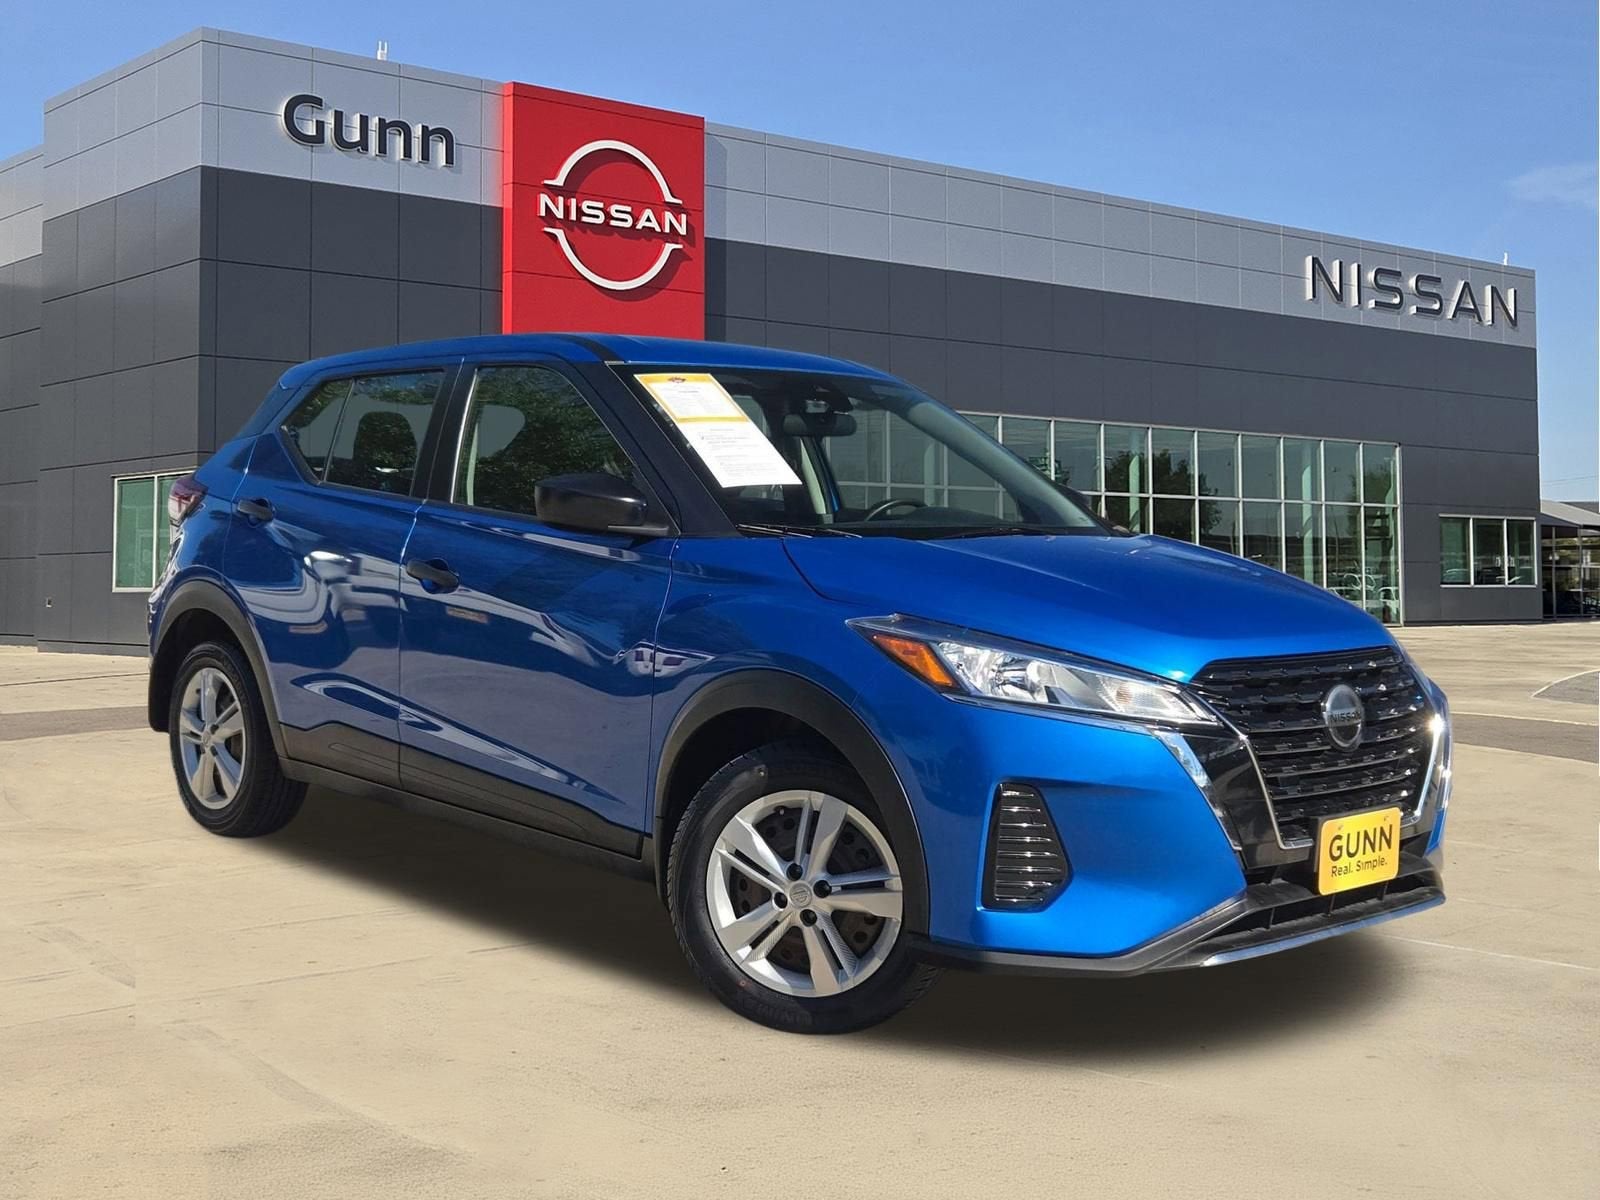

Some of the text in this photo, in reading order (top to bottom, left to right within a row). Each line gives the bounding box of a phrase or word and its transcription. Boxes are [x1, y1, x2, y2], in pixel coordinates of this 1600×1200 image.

[282, 93, 455, 167] Gunn
[538, 193, 687, 236] NISSAN
[1305, 255, 1518, 328] NISSAN
[1329, 824, 1393, 862] GUNN
[1331, 856, 1388, 877] Real. Simple.
